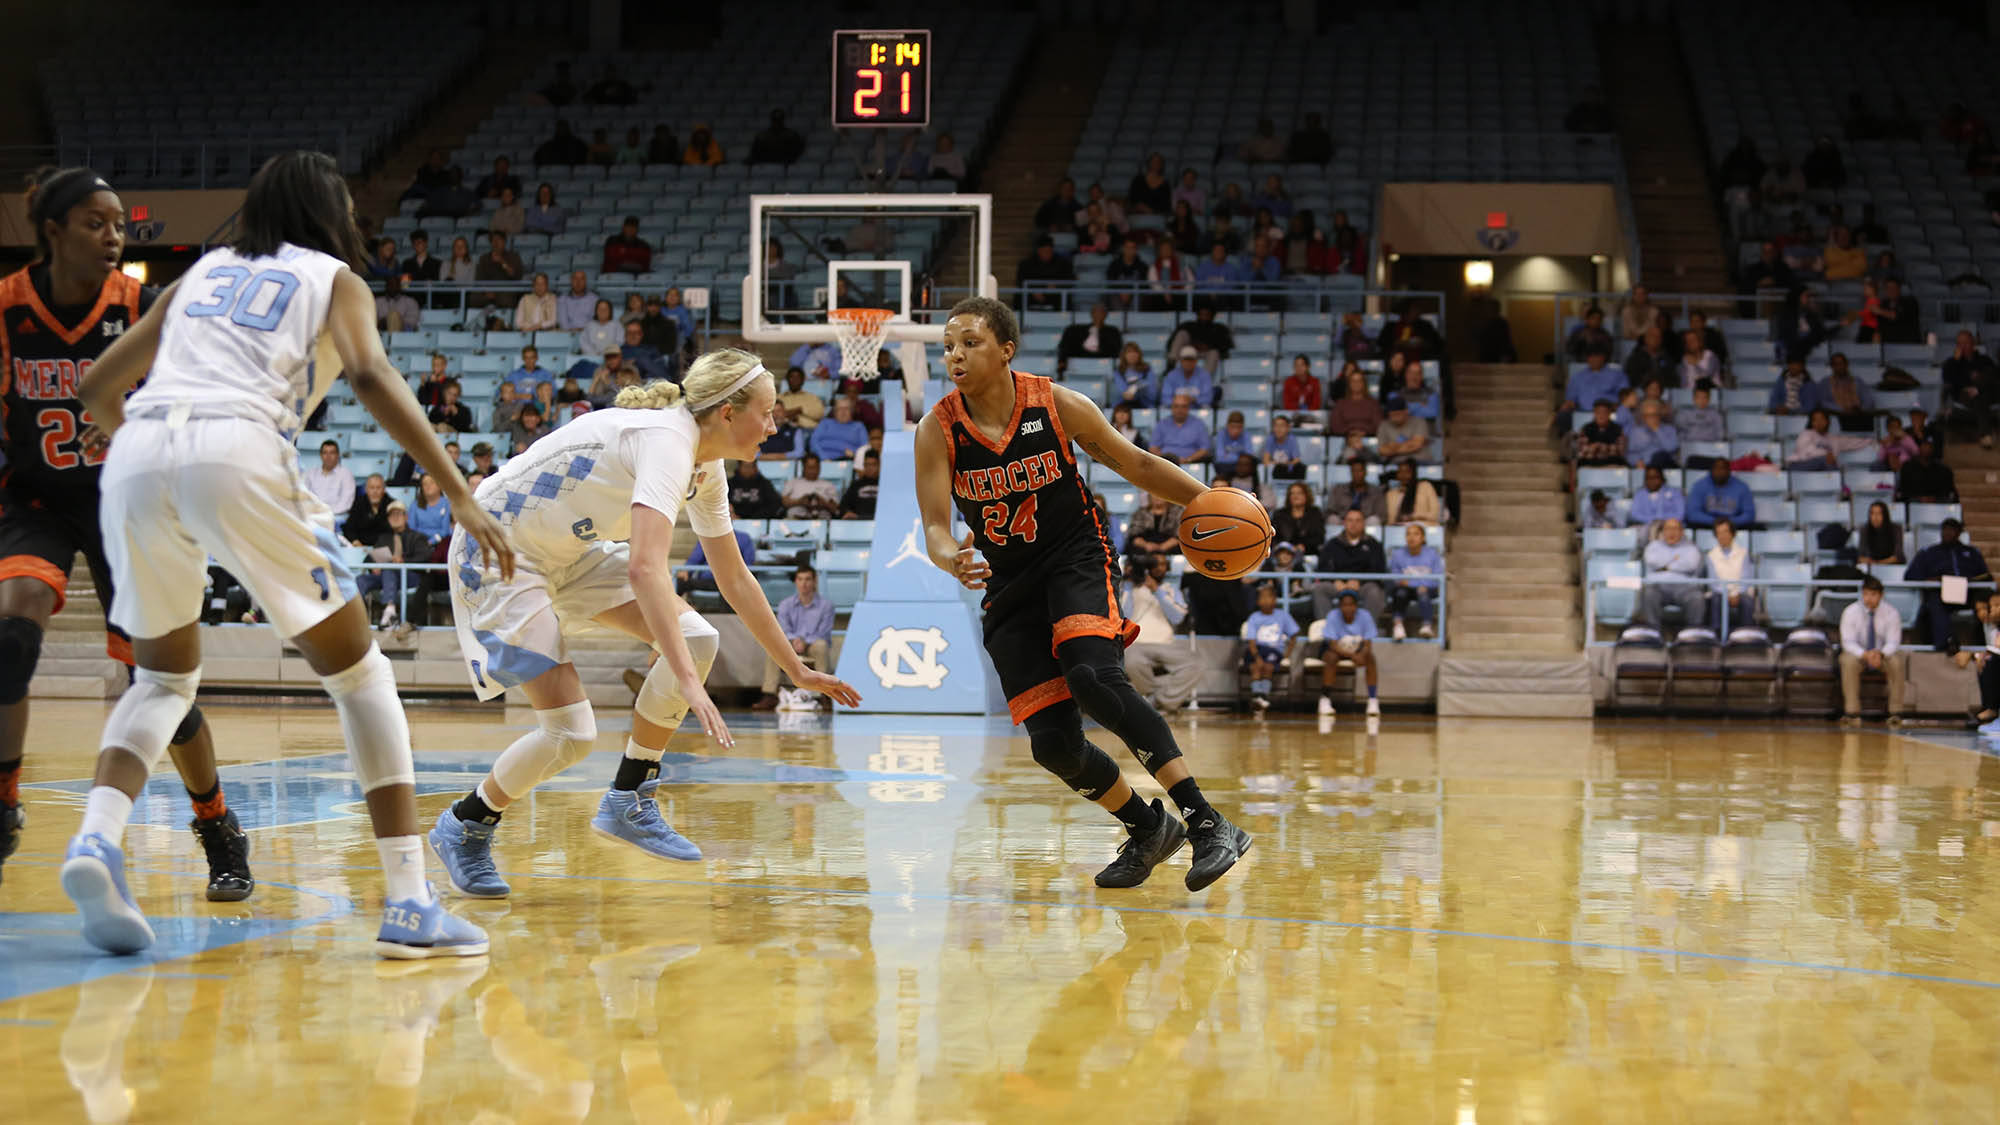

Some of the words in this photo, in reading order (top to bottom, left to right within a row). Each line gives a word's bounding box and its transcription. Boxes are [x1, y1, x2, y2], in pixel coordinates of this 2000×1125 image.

[870, 43, 921, 67] 1:14
[853, 69, 911, 117] 21
[184, 265, 301, 332] 30
[954, 450, 1062, 501] MERCER
[982, 493, 1038, 546] 24
